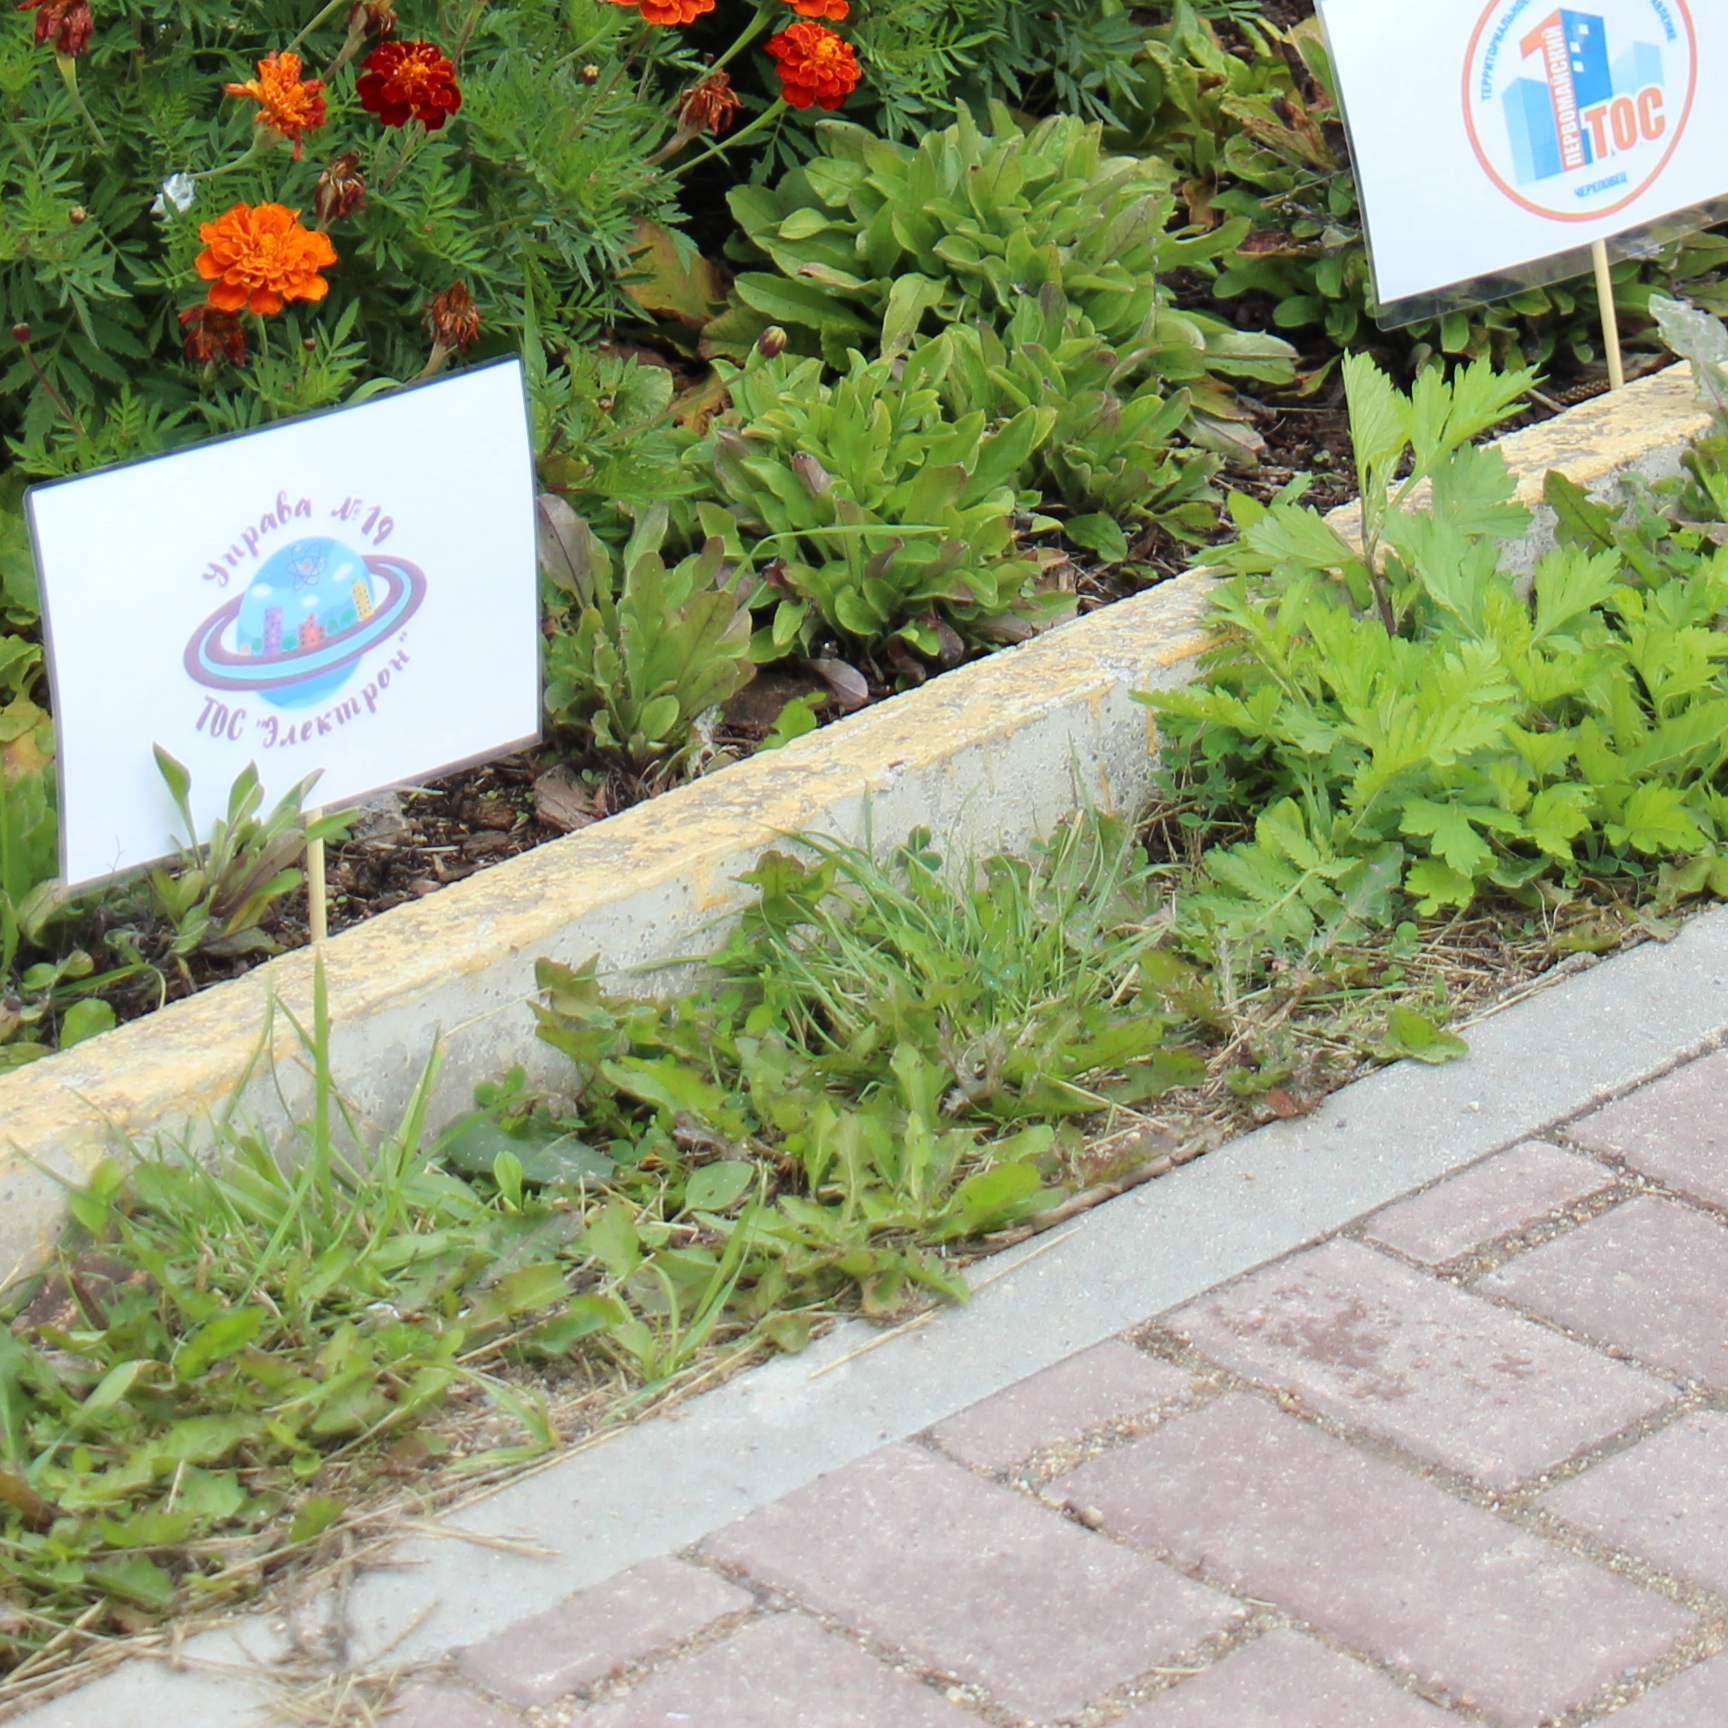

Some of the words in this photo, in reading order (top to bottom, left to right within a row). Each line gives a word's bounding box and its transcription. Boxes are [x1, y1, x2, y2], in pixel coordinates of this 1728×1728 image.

[1541, 24, 1583, 168] ПЕРВОМАЙСКИЙ
[1584, 86, 1666, 160] ТОС
[1574, 170, 1628, 198] ЧЕРЕПОВЕЦ
[202, 490, 312, 588] Управа
[195, 694, 247, 741] ТОС
